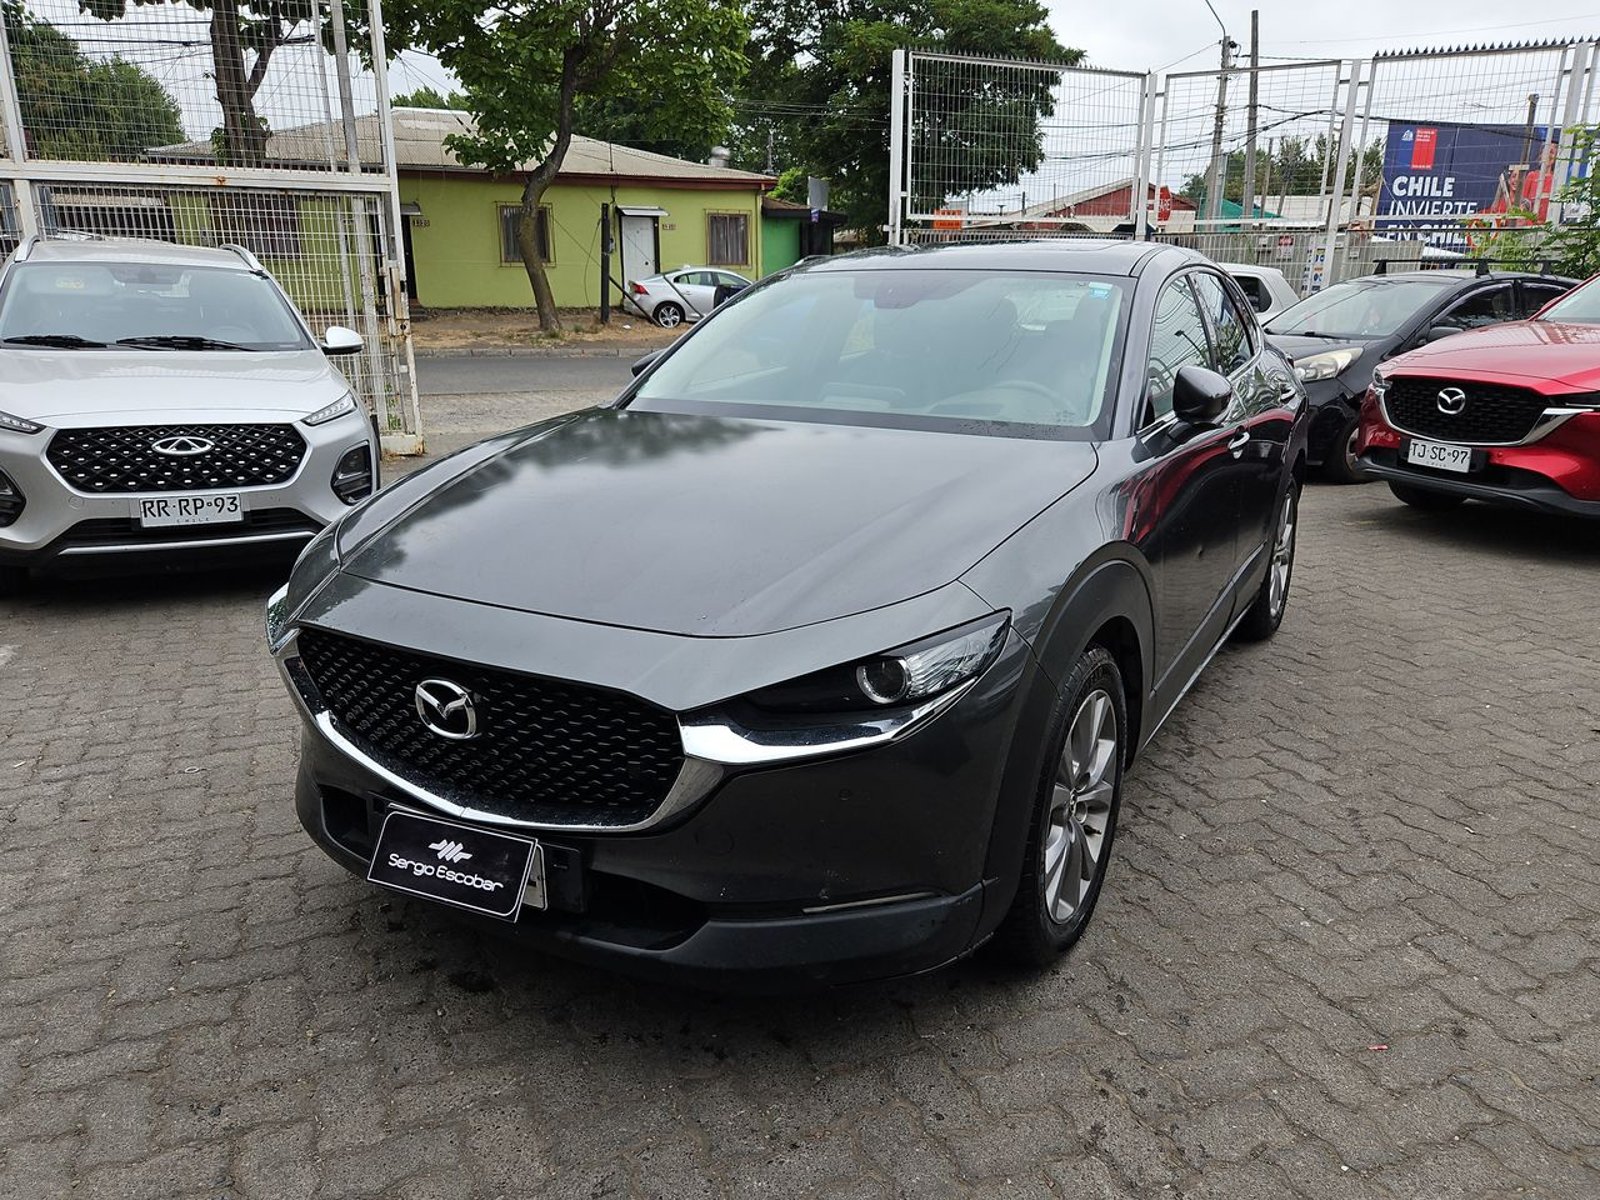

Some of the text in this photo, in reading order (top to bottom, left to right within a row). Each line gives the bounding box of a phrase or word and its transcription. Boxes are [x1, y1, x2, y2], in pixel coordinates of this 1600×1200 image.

[1392, 176, 1455, 197] CHILE
[1389, 200, 1478, 216] INVIERTE
[1416, 224, 1470, 245] CHIL
[435, 865, 504, 892] Escobar
